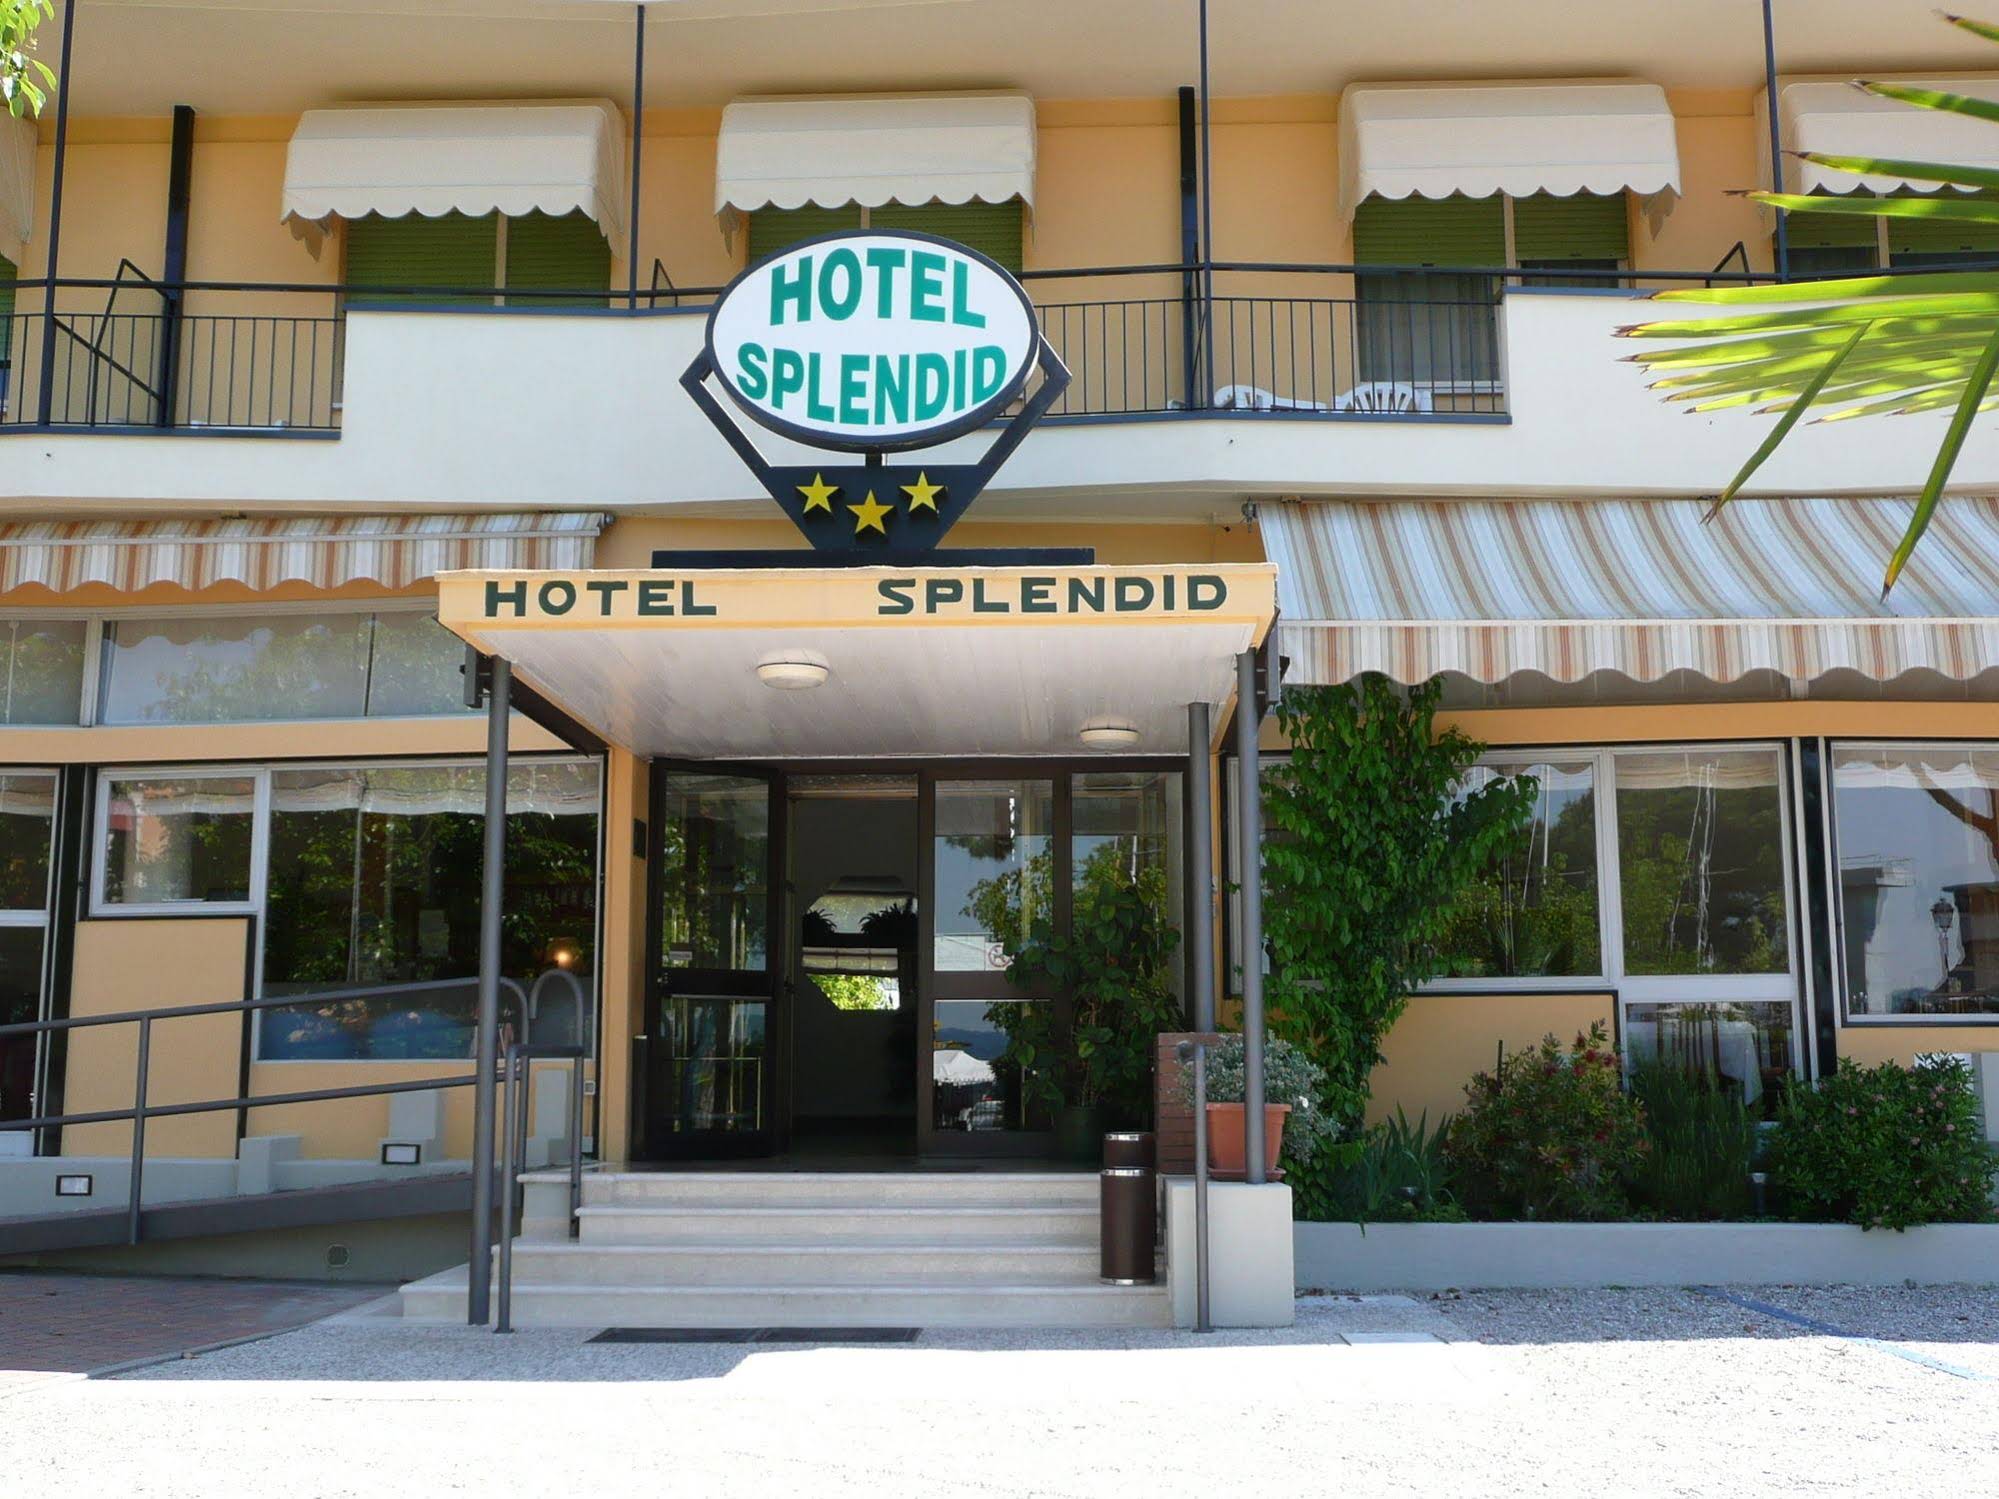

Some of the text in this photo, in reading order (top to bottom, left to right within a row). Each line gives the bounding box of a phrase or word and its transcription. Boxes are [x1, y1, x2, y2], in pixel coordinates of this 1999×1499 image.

[769, 247, 987, 330] HOTEL
[735, 341, 1008, 427] SPLENDID
[485, 574, 1227, 618] HOTEL SPLENDID
